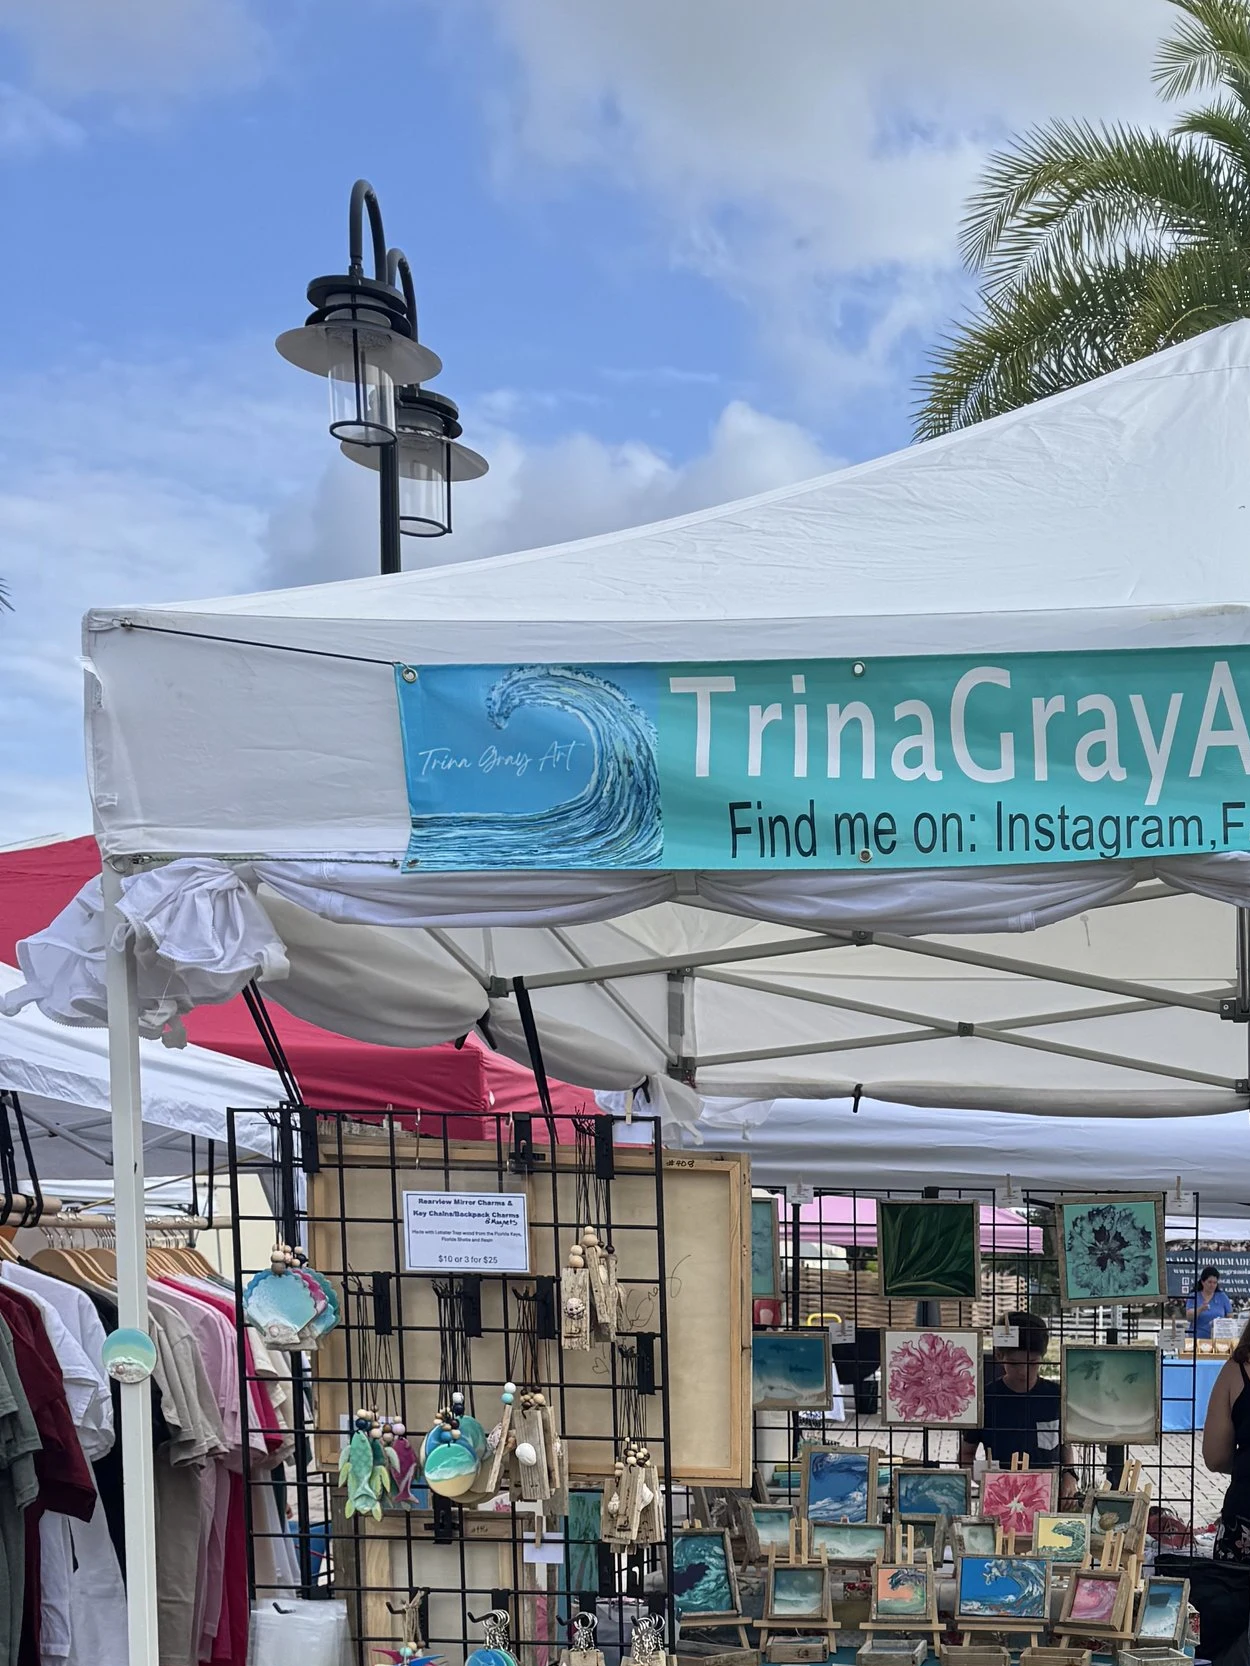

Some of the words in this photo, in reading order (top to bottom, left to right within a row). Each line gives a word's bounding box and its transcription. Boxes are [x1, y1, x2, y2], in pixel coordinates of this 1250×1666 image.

[418, 747, 472, 775] Trina
[478, 745, 533, 776] Gray
[538, 740, 586, 772] Art
[728, 800, 817, 859] Find
[834, 811, 897, 857] me
[912, 811, 977, 854] on:
[418, 1198, 452, 1206] Rearview
[453, 1198, 476, 1206] Mirror
[478, 1199, 505, 1207] Charms
[413, 1210, 427, 1218] Key
[491, 1211, 519, 1219] Charms
[438, 1255, 453, 1263] $10
[483, 1256, 498, 1264] $25
